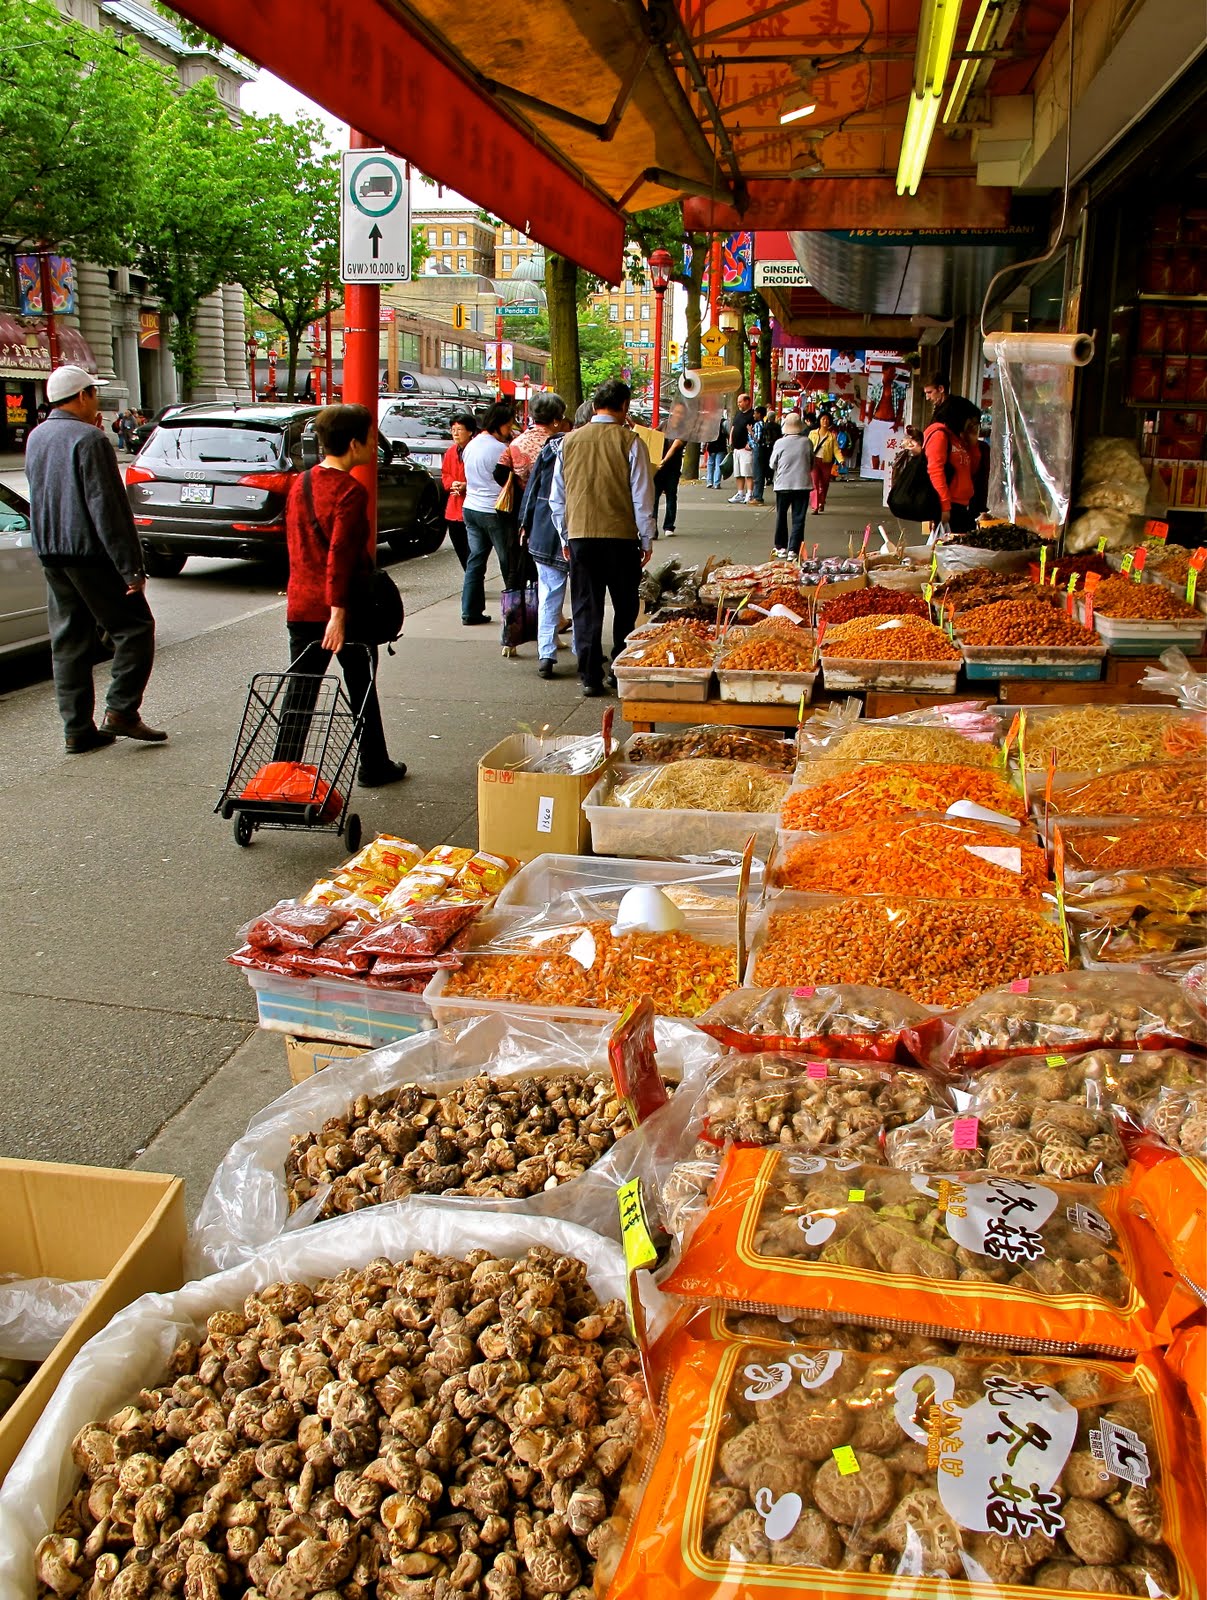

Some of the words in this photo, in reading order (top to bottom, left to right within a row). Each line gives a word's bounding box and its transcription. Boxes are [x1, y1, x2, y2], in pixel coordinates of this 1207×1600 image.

[396, 263, 406, 276] kg
[504, 306, 527, 314] Pender
[528, 306, 536, 314] St
[140, 313, 160, 328] CIBC
[787, 354, 794, 371] 5
[796, 353, 810, 371] for
[811, 353, 830, 372] $20
[941, 1398, 965, 1479] しいたけ
